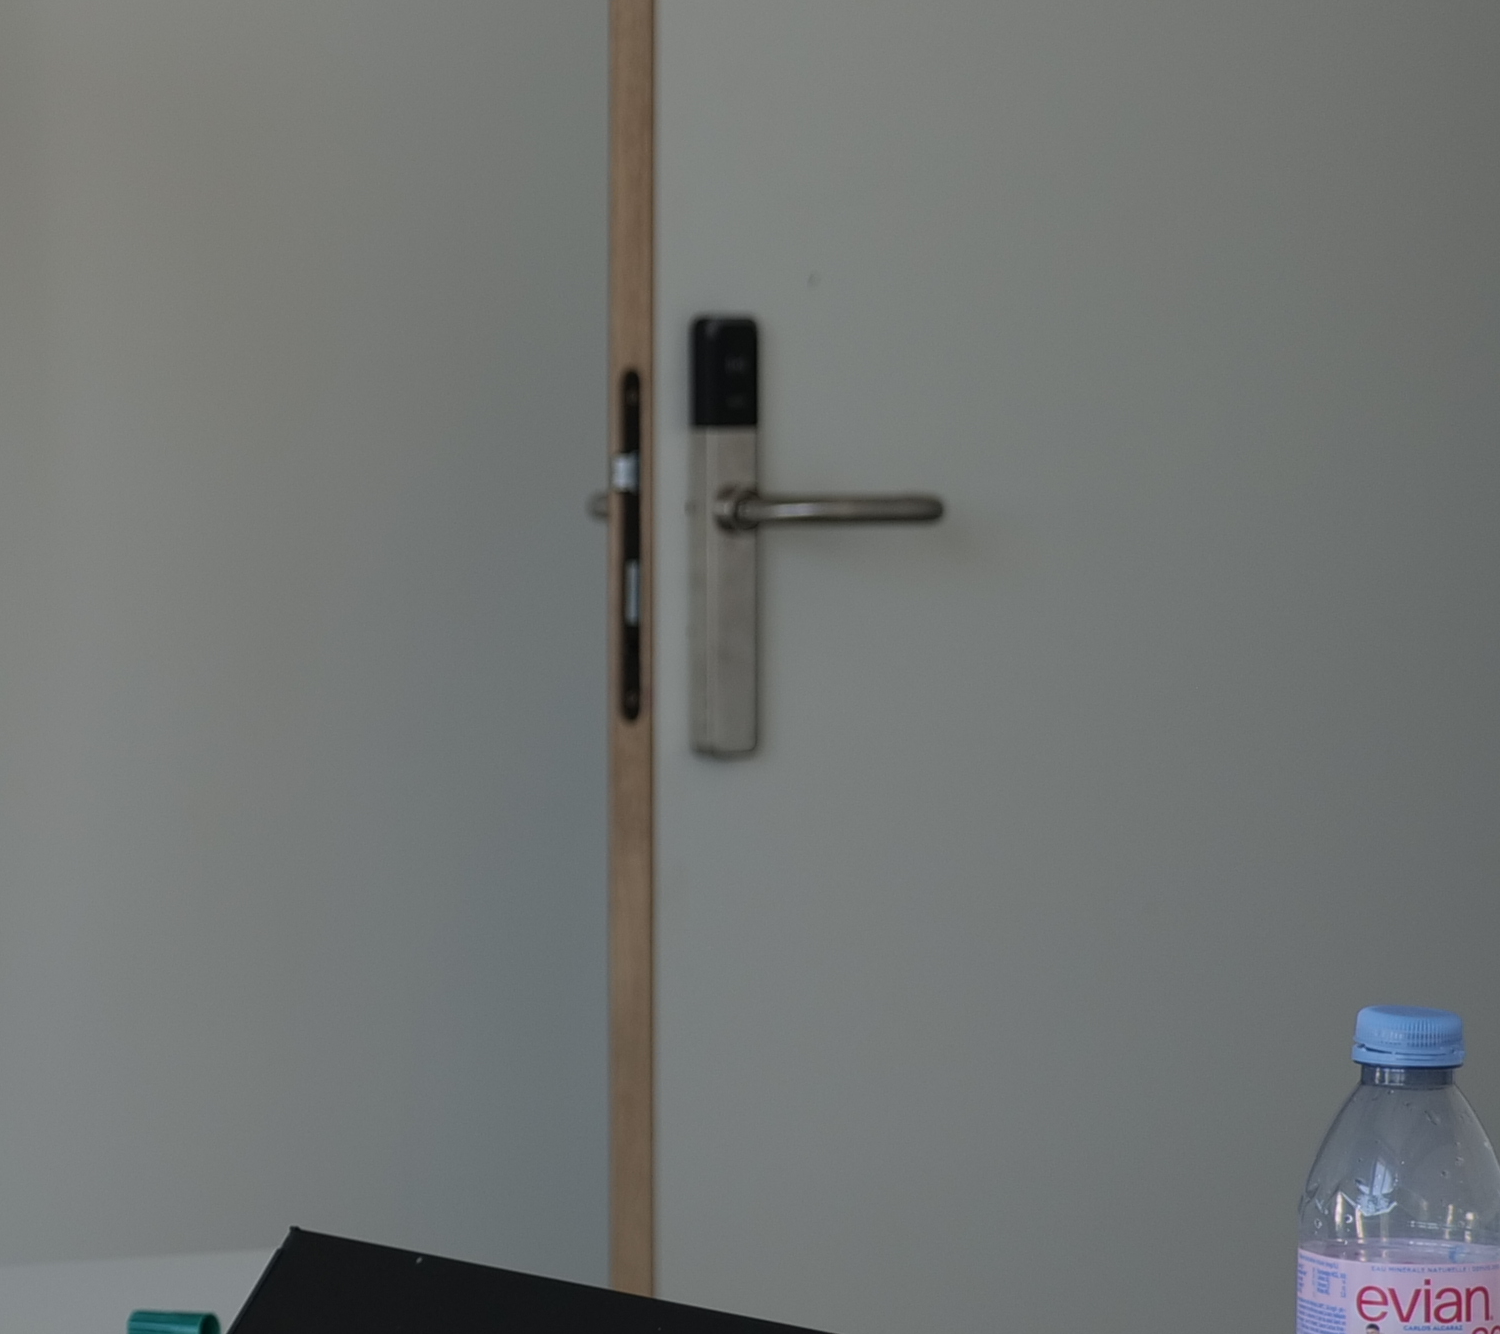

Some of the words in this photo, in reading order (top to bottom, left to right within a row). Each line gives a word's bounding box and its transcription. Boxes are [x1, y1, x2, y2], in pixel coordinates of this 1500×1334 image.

[1356, 1279, 1490, 1324] evian
[1403, 1324, 1432, 1332] CARLOS
[1433, 1324, 1464, 1332] ALCARAZ
